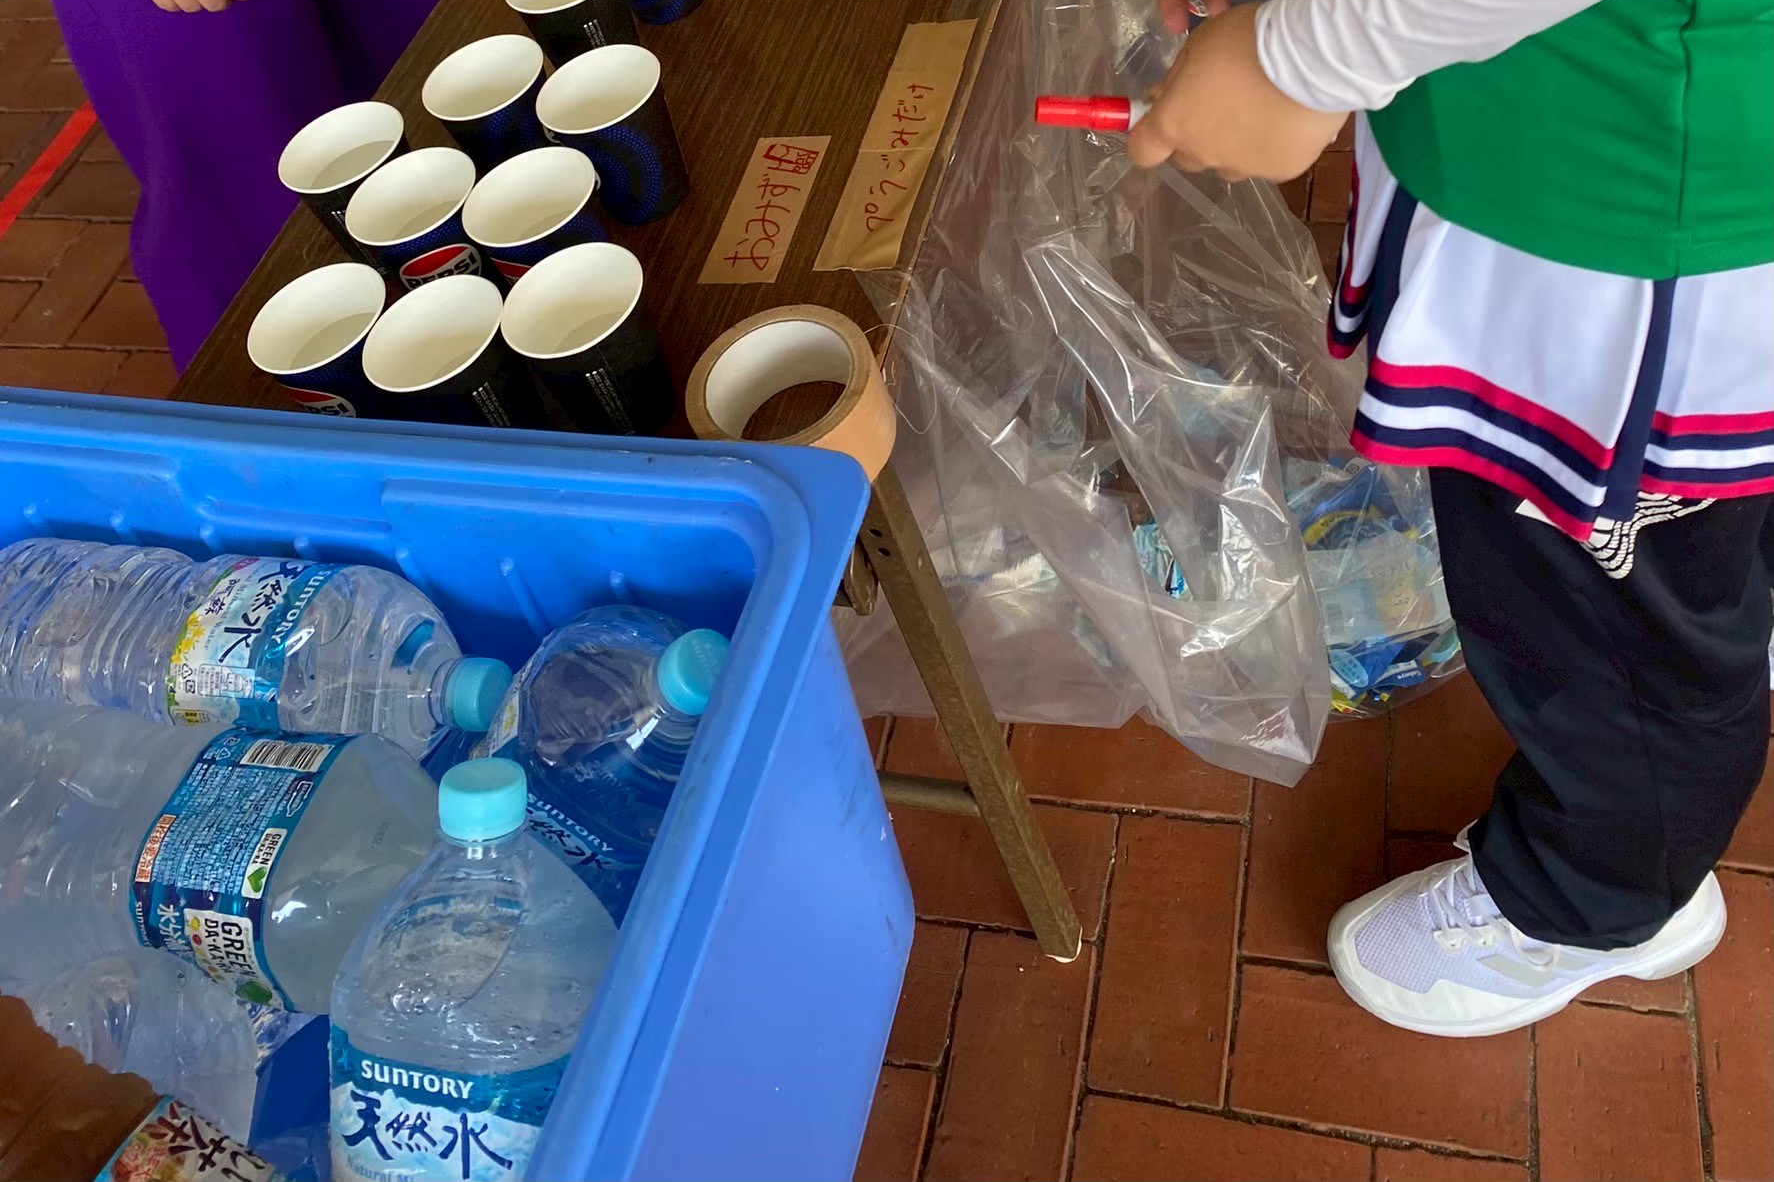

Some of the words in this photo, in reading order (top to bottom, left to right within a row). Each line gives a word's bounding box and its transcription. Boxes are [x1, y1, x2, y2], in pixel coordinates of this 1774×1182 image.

[864, 83, 934, 233] プラごみだけ
[723, 173, 801, 271] おみず
[218, 561, 312, 664] 天然水
[270, 569, 332, 644] SUNTORY
[259, 833, 282, 866] GREEN
[526, 806, 613, 870] 然水
[527, 793, 614, 853] SUNTORY
[221, 921, 259, 978] GREEN
[360, 1059, 474, 1100] SUNTORY
[341, 1089, 513, 1180] 天然水
